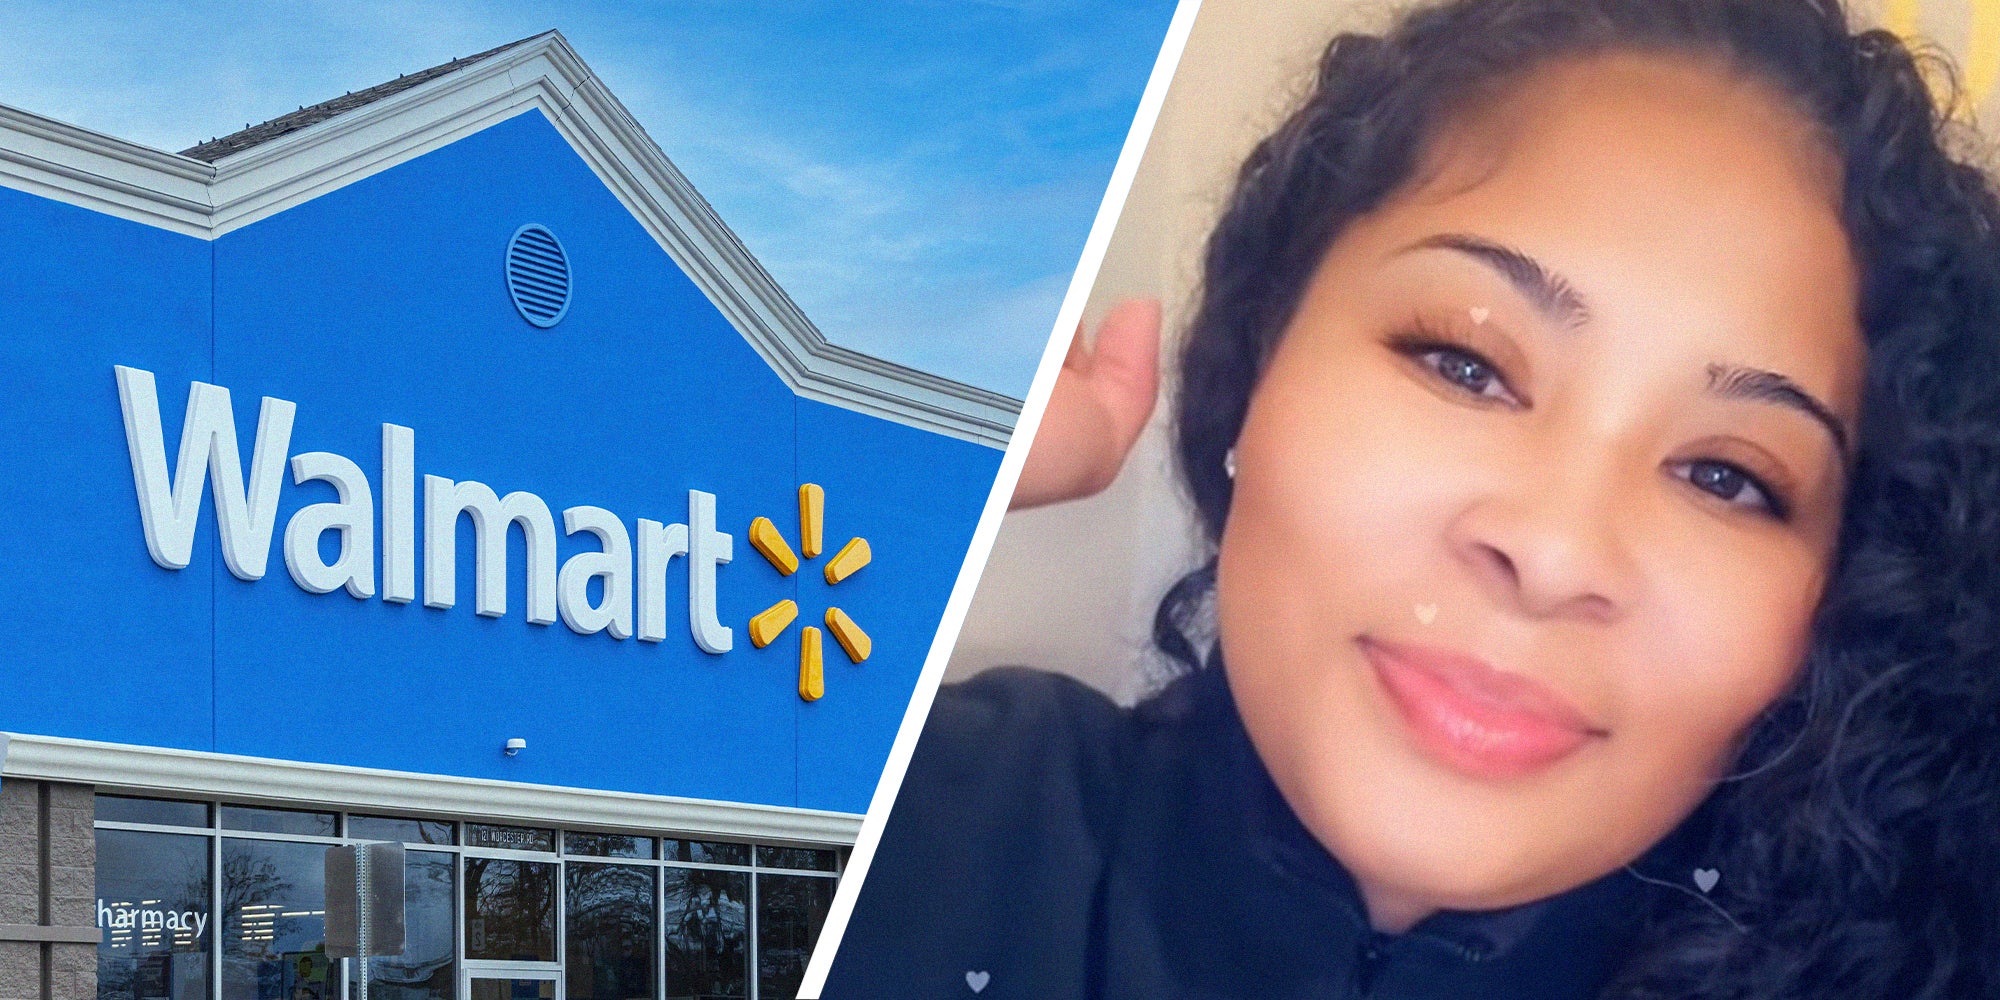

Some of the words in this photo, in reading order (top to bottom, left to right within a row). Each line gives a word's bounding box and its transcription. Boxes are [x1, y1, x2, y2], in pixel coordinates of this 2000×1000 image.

[114, 365, 733, 654] Walmart
[491, 831, 524, 844] WORCESTER
[97, 898, 208, 938] harmacy
